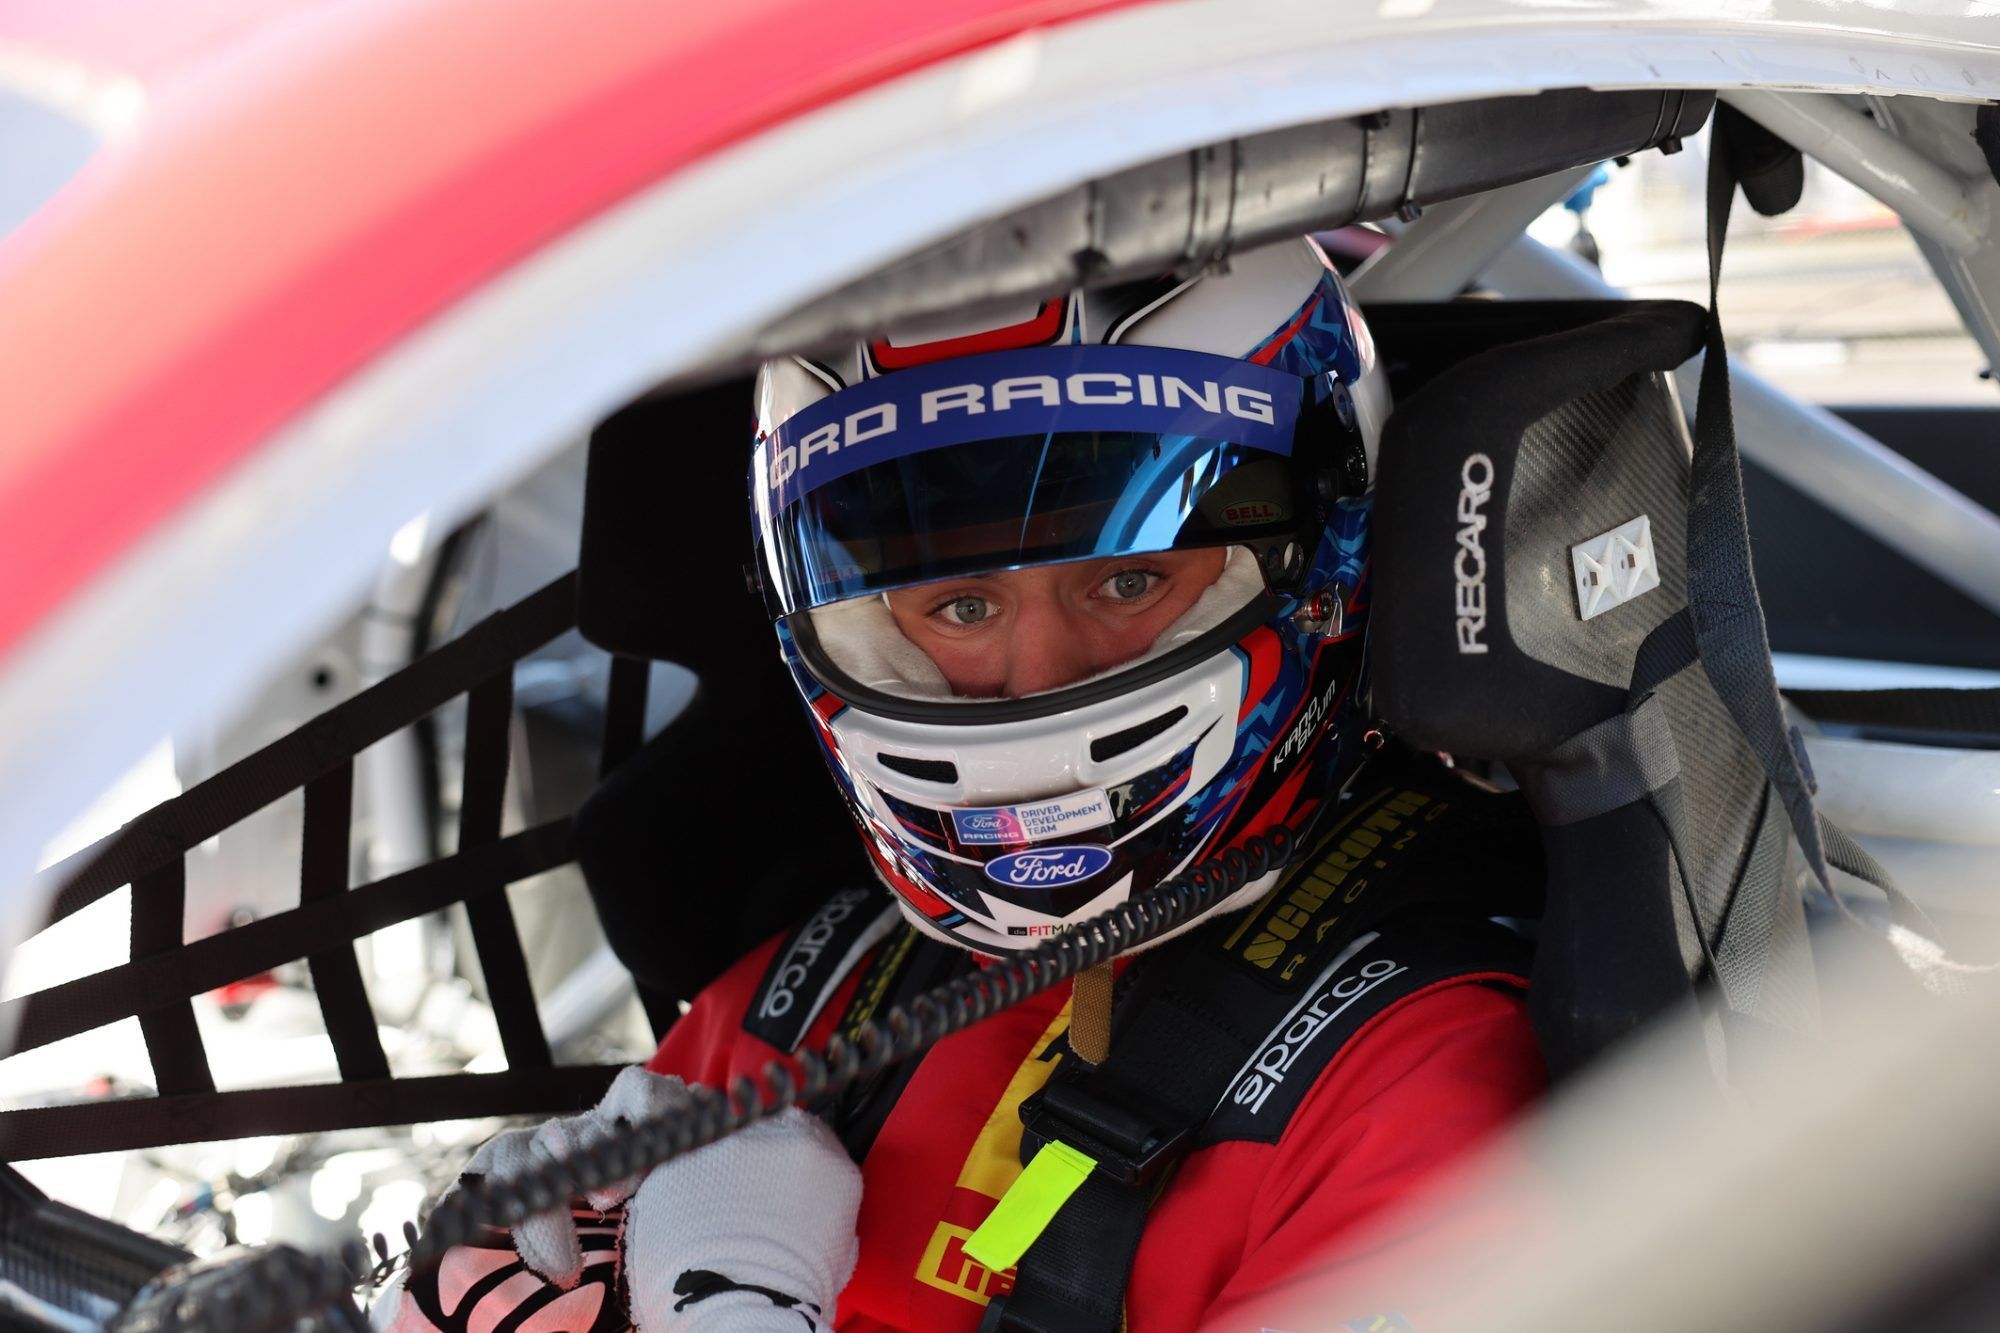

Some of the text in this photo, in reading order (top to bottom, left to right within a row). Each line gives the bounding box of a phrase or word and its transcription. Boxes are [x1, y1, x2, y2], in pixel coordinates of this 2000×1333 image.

[921, 373, 1275, 425] RACING
[1226, 504, 1274, 520] BELL
[1454, 453, 1495, 654] RECARO
[971, 815, 1002, 829] Ford
[1021, 804, 1062, 819] DRIVER
[1023, 802, 1103, 827] DEVELOPMENT
[963, 831, 1020, 840] RACING
[1027, 824, 1057, 836] TEAM
[1009, 852, 1087, 883] Ford
[1243, 790, 1432, 969] SCHROTH
[1280, 802, 1449, 981] RACING
[1233, 959, 1398, 1116] sparco
